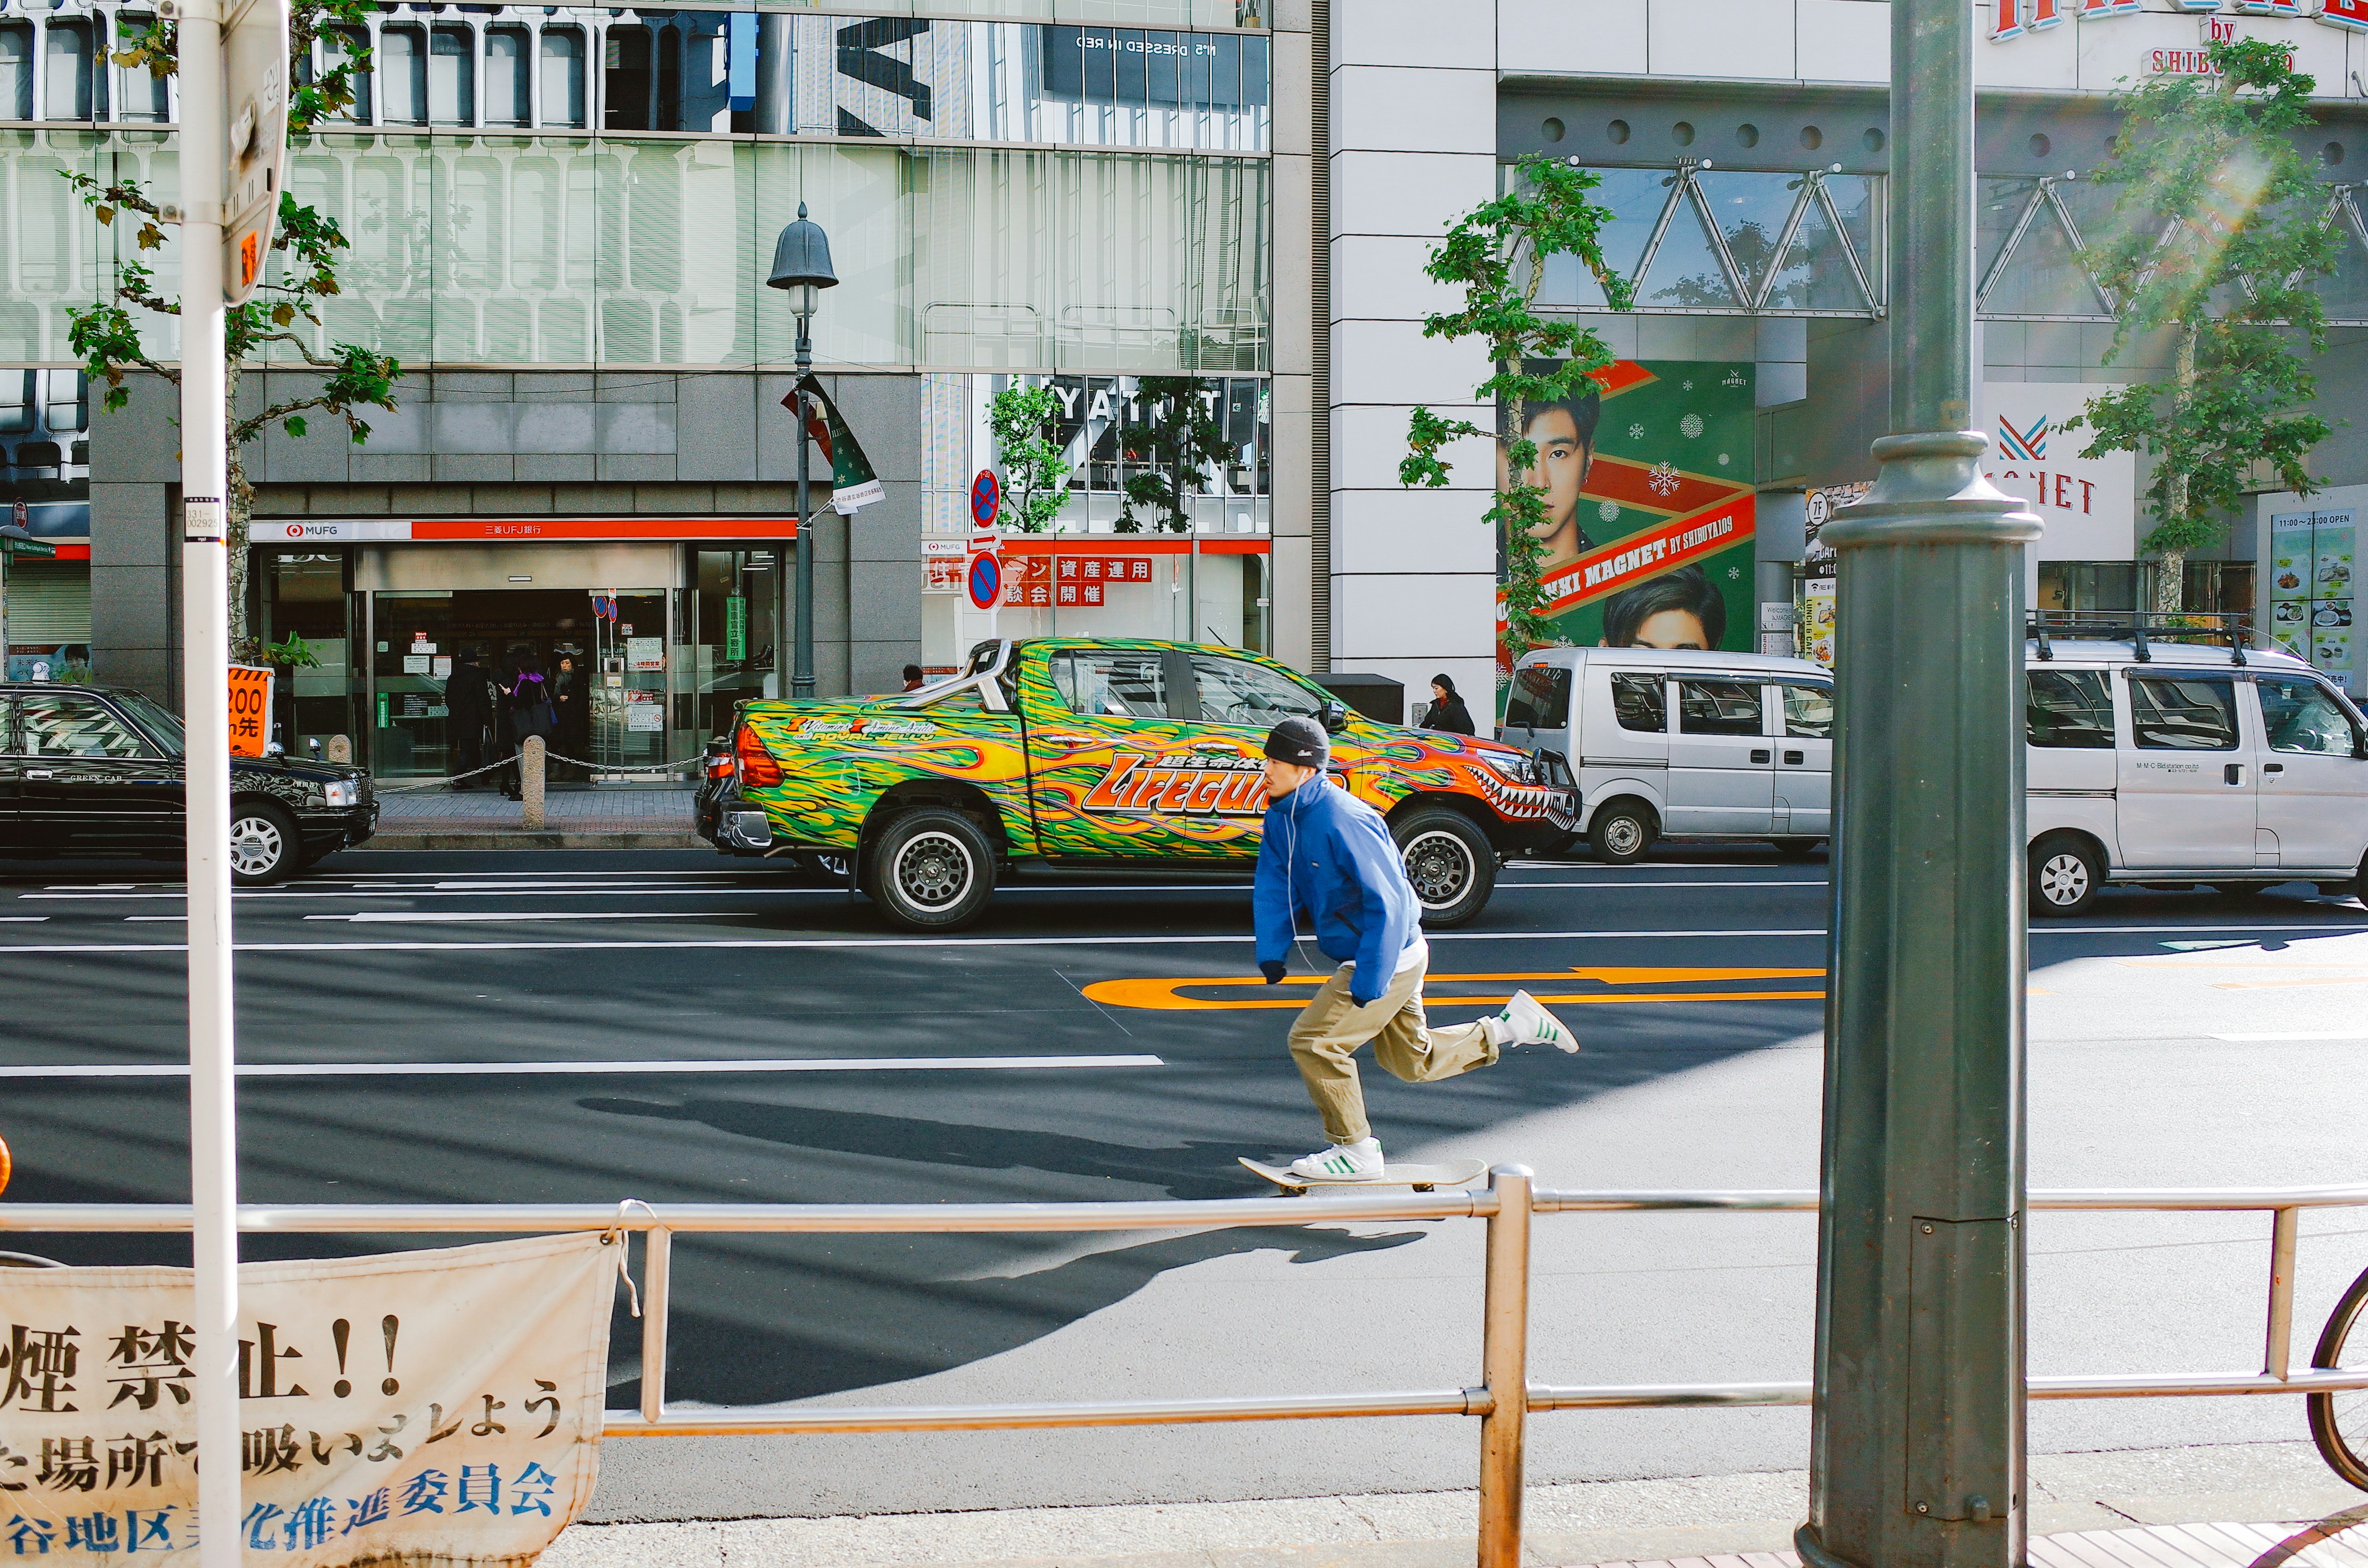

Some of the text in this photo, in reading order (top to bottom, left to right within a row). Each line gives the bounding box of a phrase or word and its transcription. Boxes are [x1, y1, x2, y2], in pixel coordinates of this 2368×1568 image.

[2211, 18, 2234, 46] by
[187, 510, 210, 518] 331-
[1813, 501, 1822, 516] 7F
[187, 519, 218, 527] 002925
[2330, 514, 2350, 524] OPEN
[306, 527, 337, 535] MUFG
[485, 525, 542, 534] 三菱UFJ銀行
[1584, 515, 1733, 588] MAGNET BY SHIBUYA109
[933, 560, 1047, 579] 住宅ーン
[1060, 560, 1149, 578] 資産運用
[1060, 585, 1101, 603] 開催
[804, 720, 852, 731] Vitamins
[863, 720, 900, 733] Amino
[900, 721, 936, 733] Acids
[812, 733, 875, 741] ROYAL
[875, 733, 936, 741] JELLY
[0, 1378, 561, 1493] 場所吸いましょう
[5, 1461, 558, 1555] 谷地区化推進委員会
